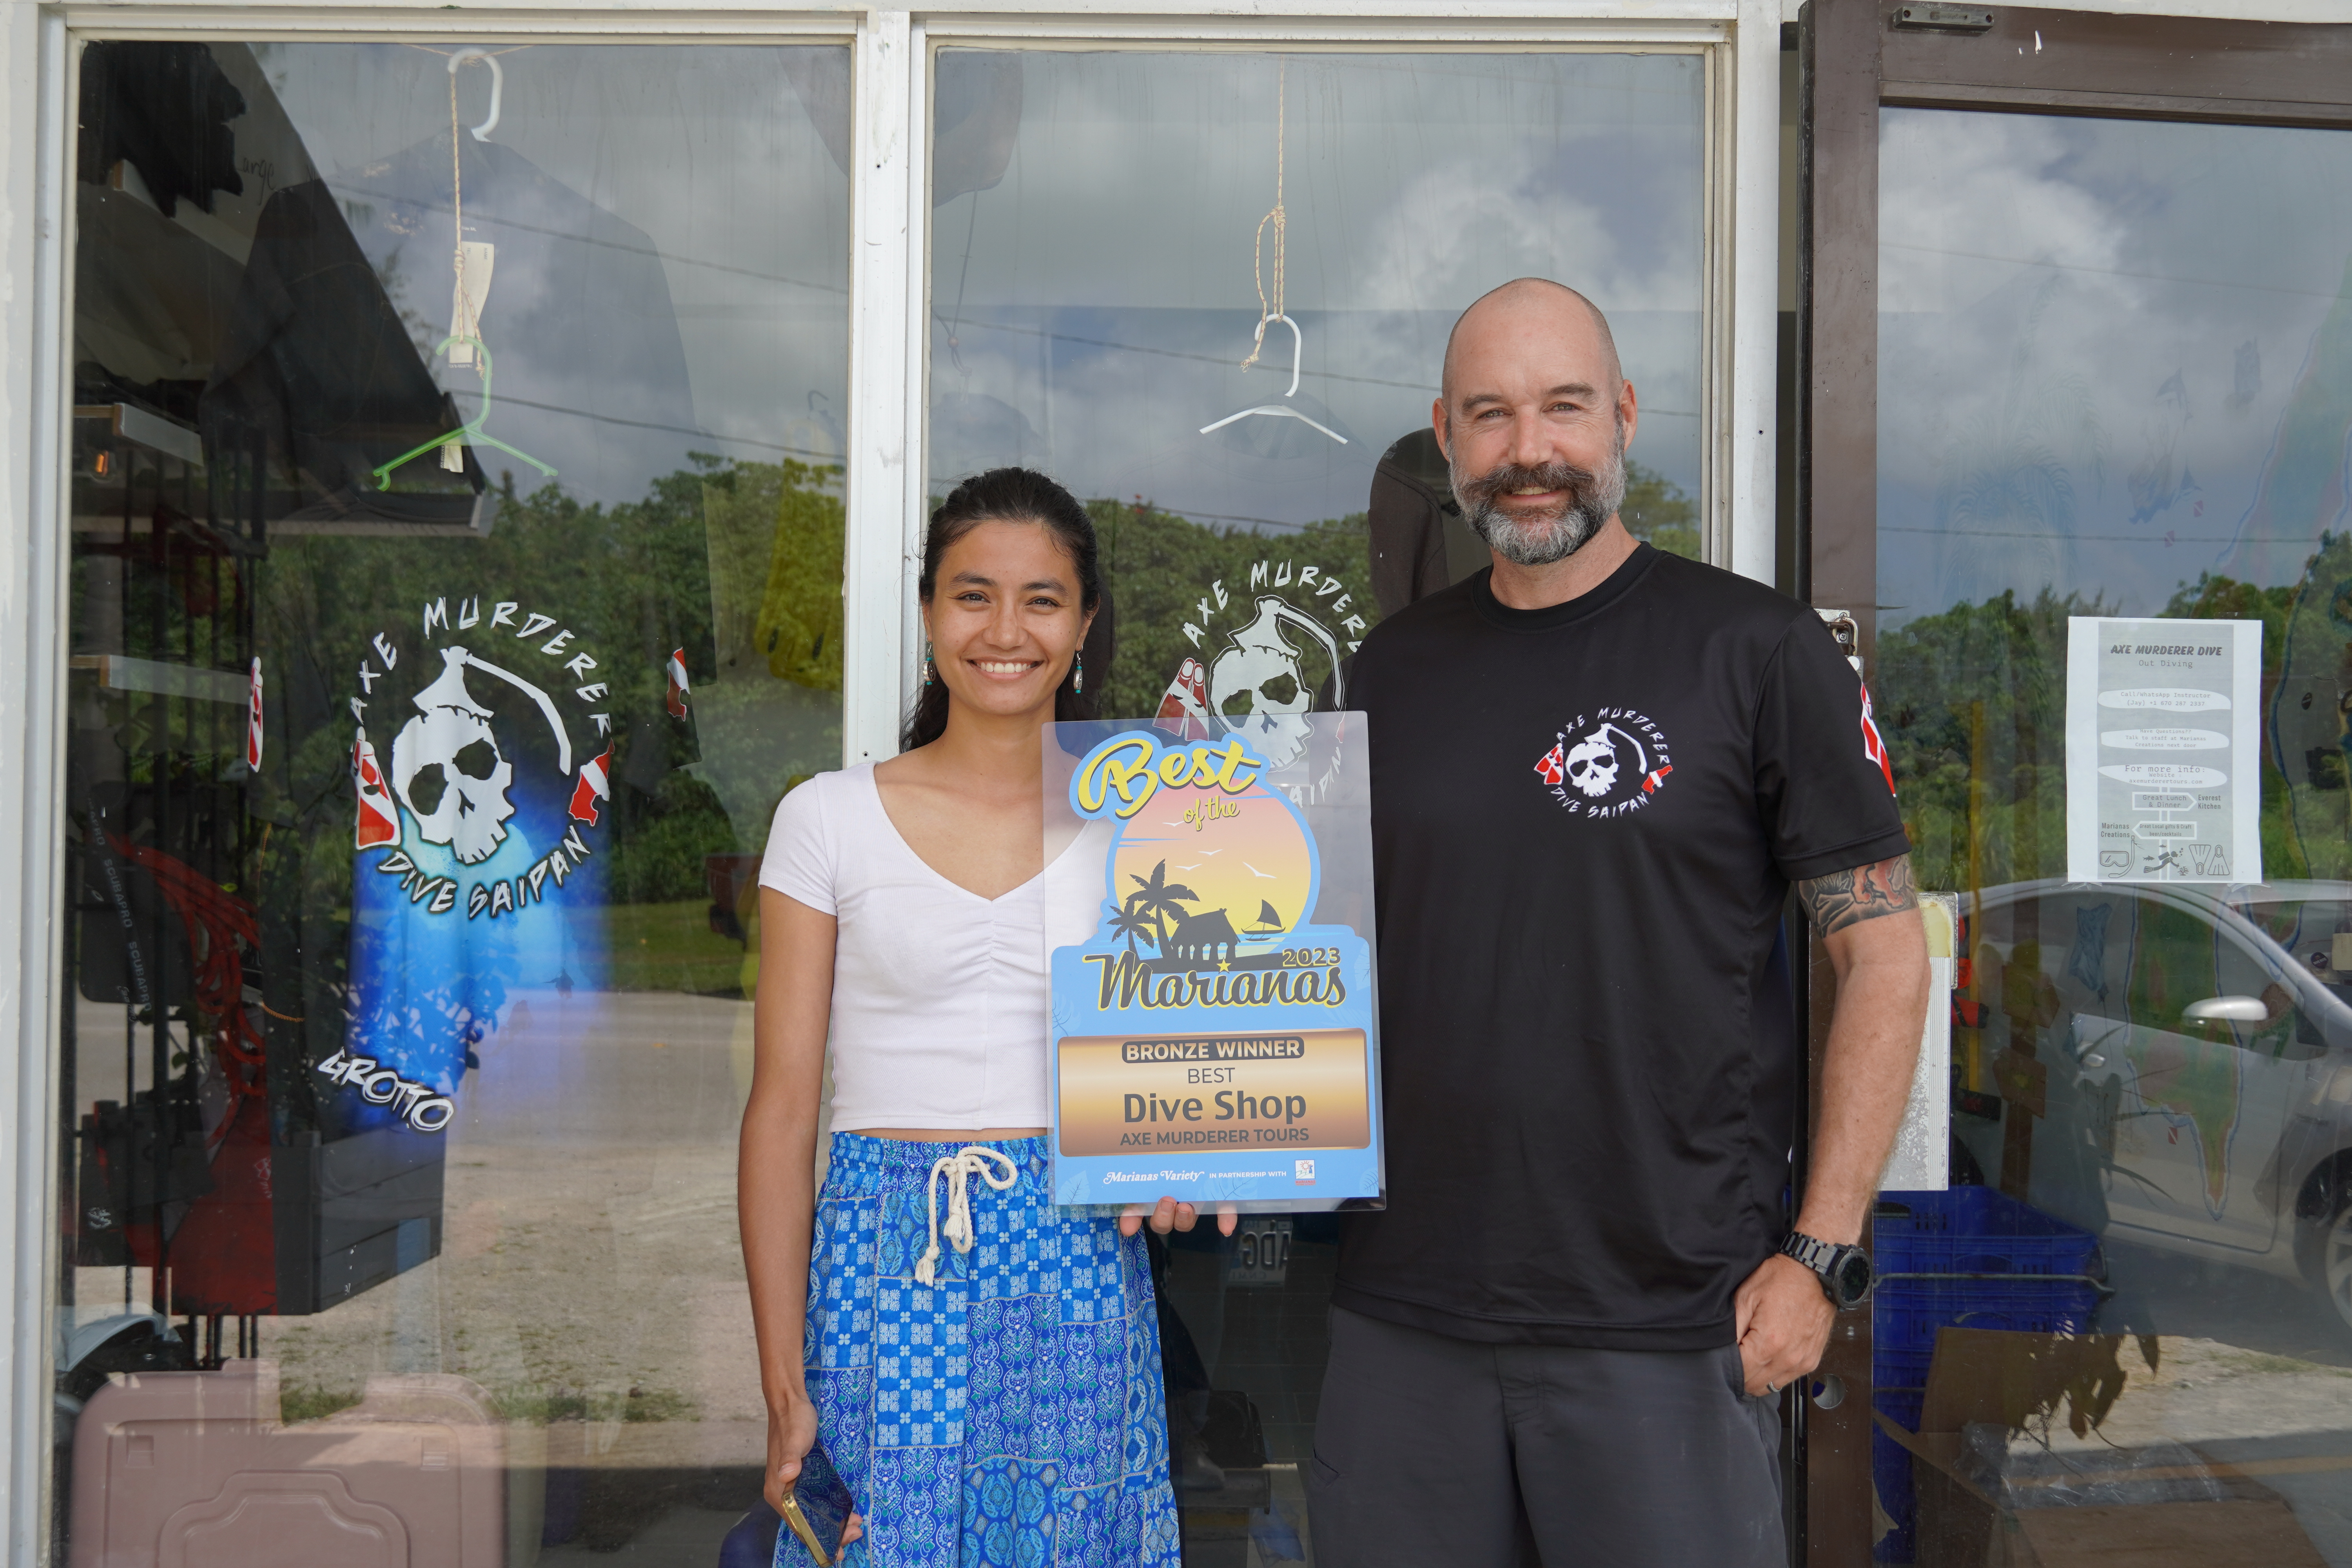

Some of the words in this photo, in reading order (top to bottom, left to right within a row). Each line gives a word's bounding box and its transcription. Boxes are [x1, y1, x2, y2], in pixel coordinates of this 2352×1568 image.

[237, 157, 276, 206] arge
[1182, 579, 1228, 649] AXE
[1251, 559, 1367, 652] MURDERE
[350, 632, 397, 724] AXE
[425, 593, 612, 738] MURDERER
[2111, 644, 2132, 654] AXE
[2135, 645, 2194, 655] MURDERER
[2198, 646, 2222, 656] DIVE
[2161, 660, 2193, 668] Diving
[1556, 714, 1585, 743] AXE
[1597, 707, 1670, 764] MURDERER
[1078, 739, 1261, 820] Best
[1275, 746, 1341, 808] AIPAN
[1183, 799, 1204, 831] of
[1205, 795, 1240, 819] the
[1550, 787, 1581, 812] DIVE
[1587, 791, 1649, 819] SAIPAN
[103, 858, 133, 928] SCUBAPRO
[378, 851, 457, 912] DIVE
[469, 824, 591, 918] SAIPAN
[128, 941, 152, 1012] SCUBAPRO
[1082, 950, 1347, 1011] Marianas
[1282, 947, 1341, 967] 2023
[1126, 1042, 1209, 1061] BRONZE
[1216, 1039, 1301, 1058] WINNER
[318, 1046, 454, 1131] GROTTO
[1187, 1067, 1236, 1084] BEST
[1124, 1092, 1203, 1123] Dive
[1214, 1090, 1307, 1125] Shop
[1120, 1132, 1152, 1146] AXE
[1156, 1129, 1249, 1145] MURDERER
[1254, 1127, 1309, 1142] TOURS
[1103, 1171, 1158, 1184] Marianas
[1160, 1170, 1205, 1181] Variety
